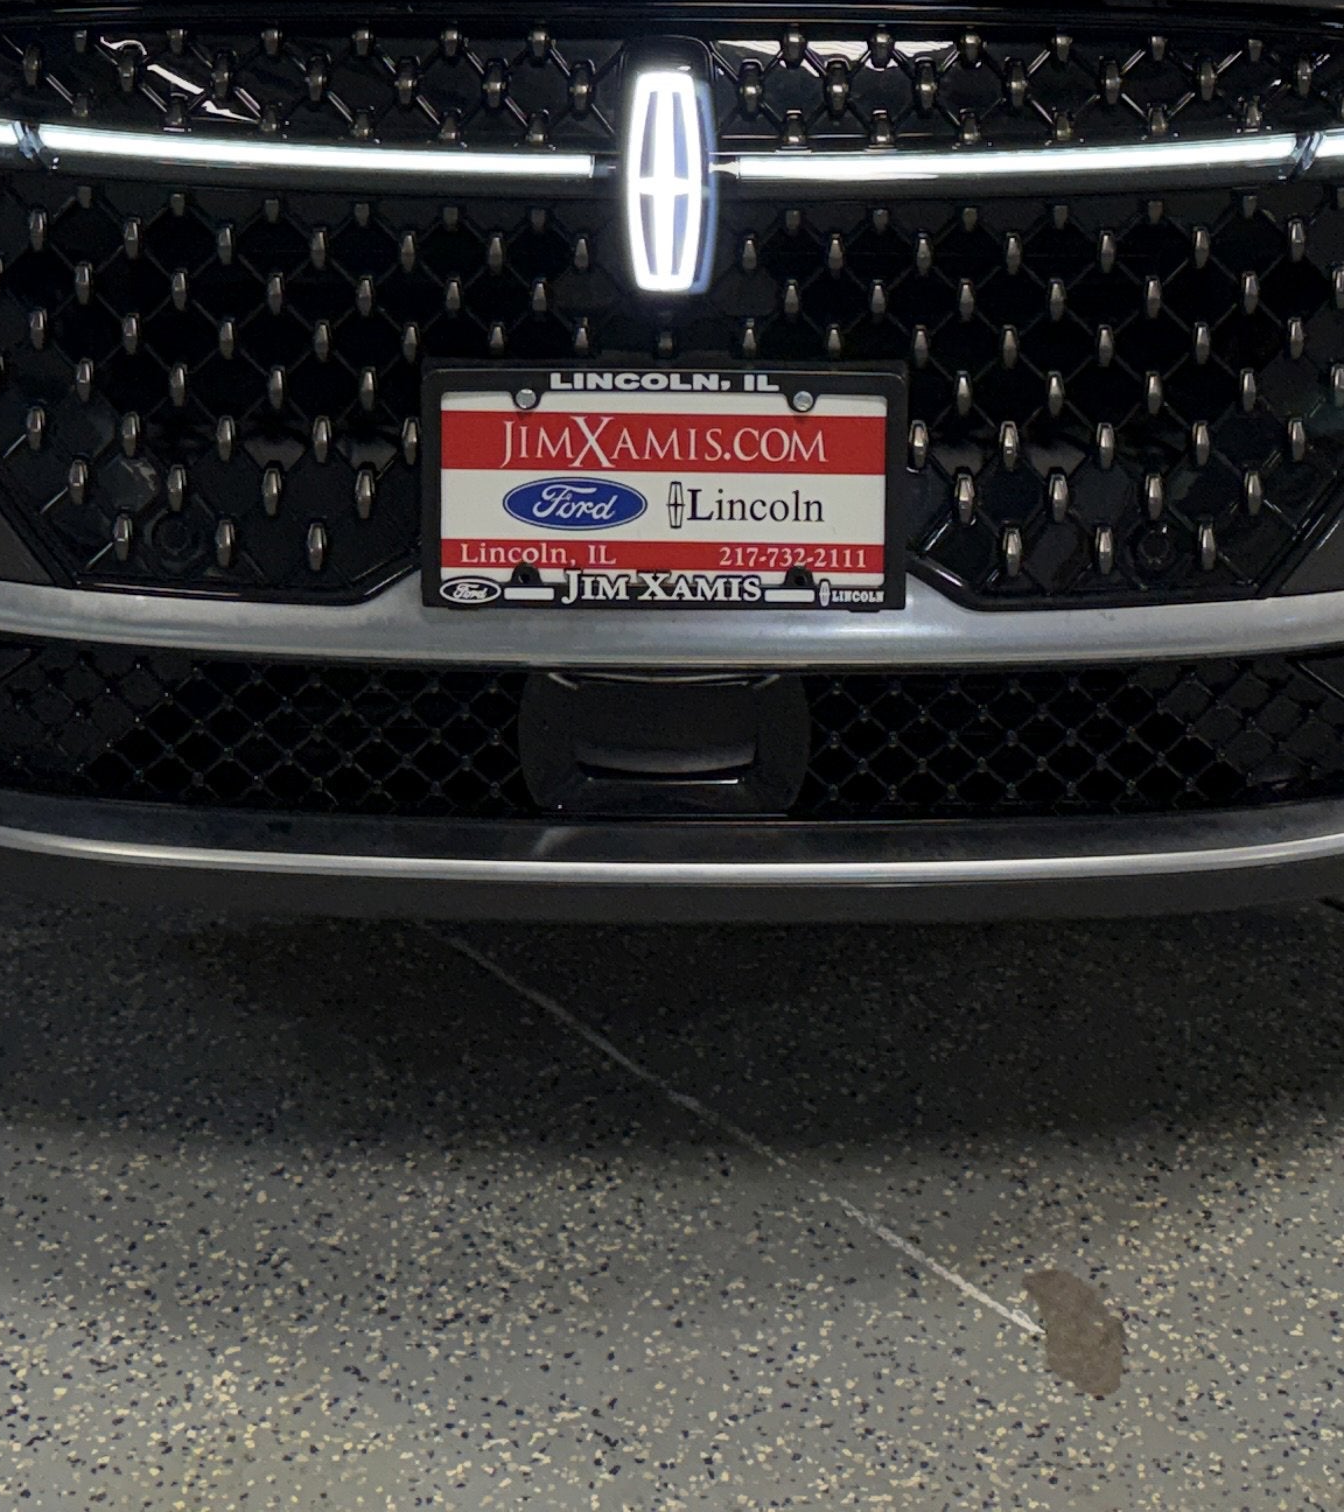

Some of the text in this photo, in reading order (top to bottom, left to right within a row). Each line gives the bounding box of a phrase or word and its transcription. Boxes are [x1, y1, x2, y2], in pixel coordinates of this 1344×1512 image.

[549, 372, 780, 392] LINCOLN, IL
[499, 415, 829, 469] JIMXAMIS.COM
[532, 486, 618, 522] Ford
[687, 489, 825, 523] Lincoln
[460, 542, 617, 566] Lincoln, IL
[718, 546, 867, 569] 217-732-2111
[452, 581, 489, 601] Ford
[561, 569, 762, 605] JIM XAMIS
[831, 590, 885, 603] LINCOLN
